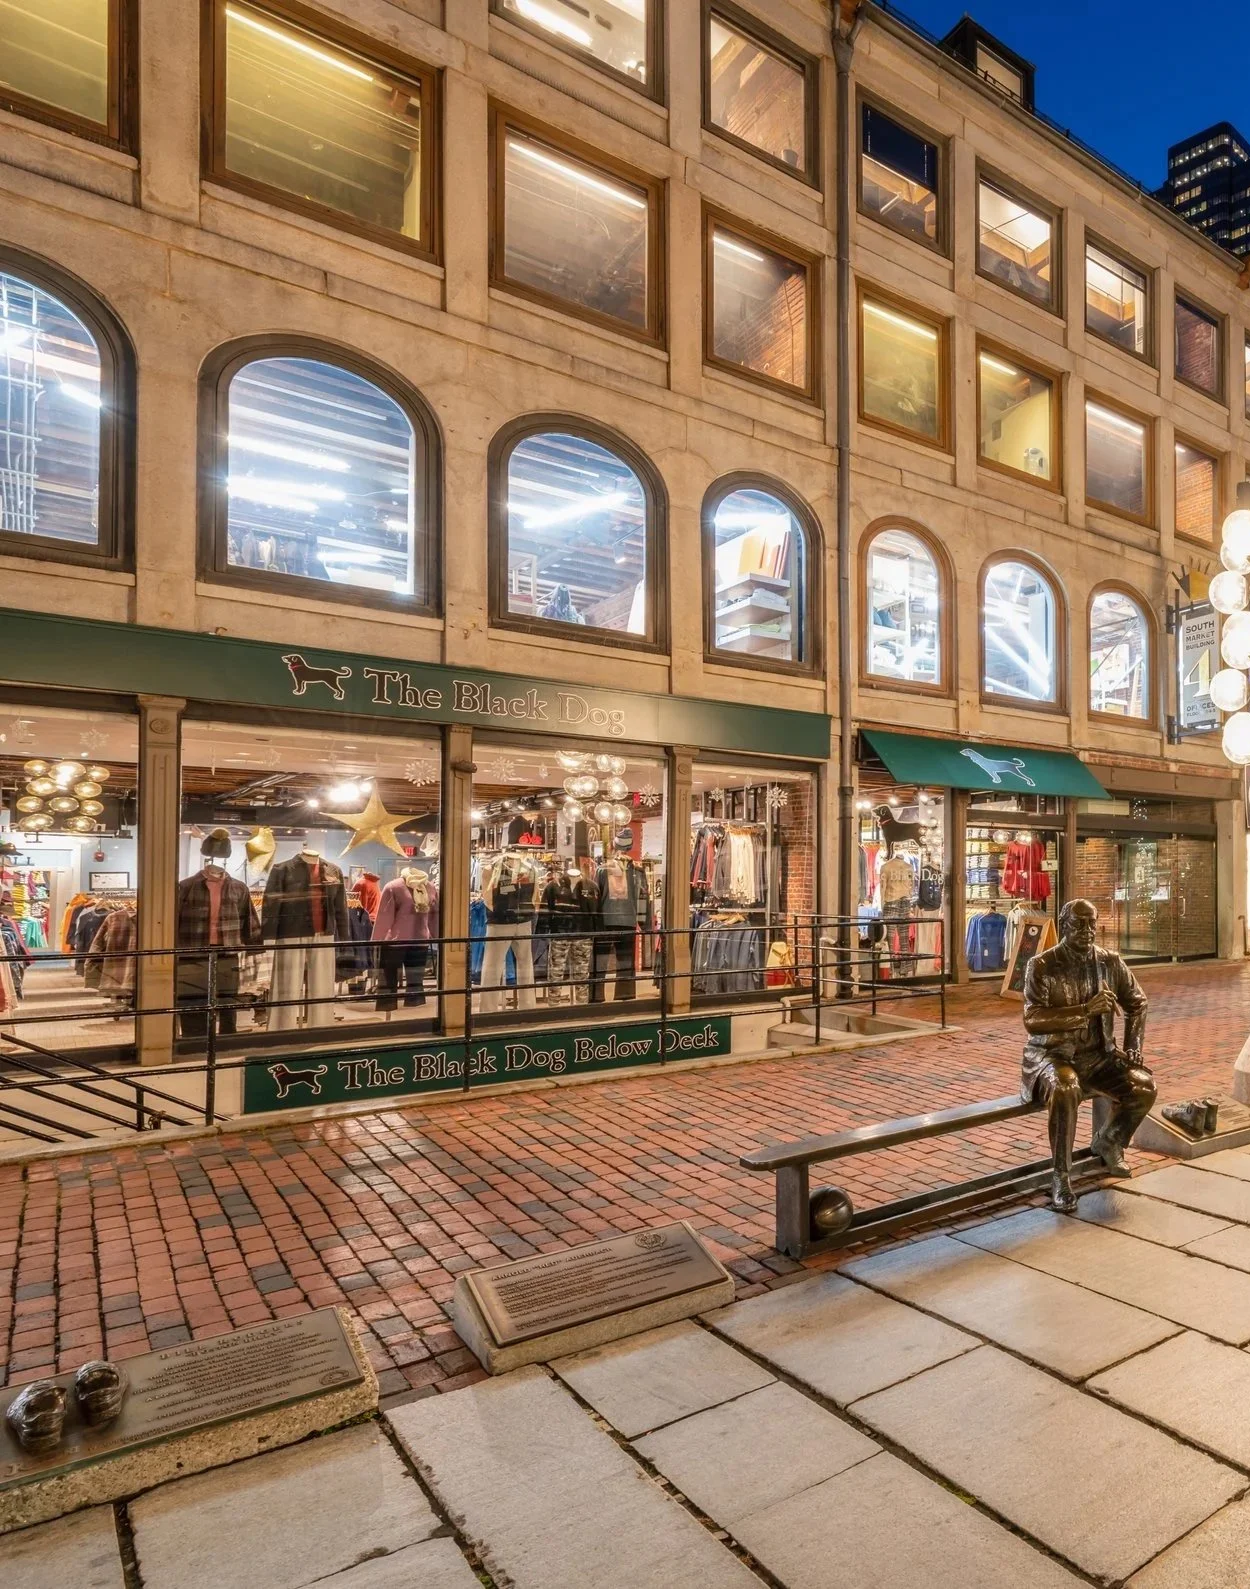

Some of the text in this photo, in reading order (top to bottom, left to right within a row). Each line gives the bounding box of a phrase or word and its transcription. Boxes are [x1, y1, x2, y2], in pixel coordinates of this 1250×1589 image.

[1186, 621, 1215, 633] SOUTH
[1186, 631, 1215, 642] MARKET
[1186, 640, 1215, 650] BUILDING
[1184, 649, 1212, 697] 4
[363, 667, 626, 737] The Black Dog
[921, 869, 944, 884] Dog
[337, 1025, 719, 1090] The Black Dog Below Deck
[491, 1266, 531, 1281] ARNOLD
